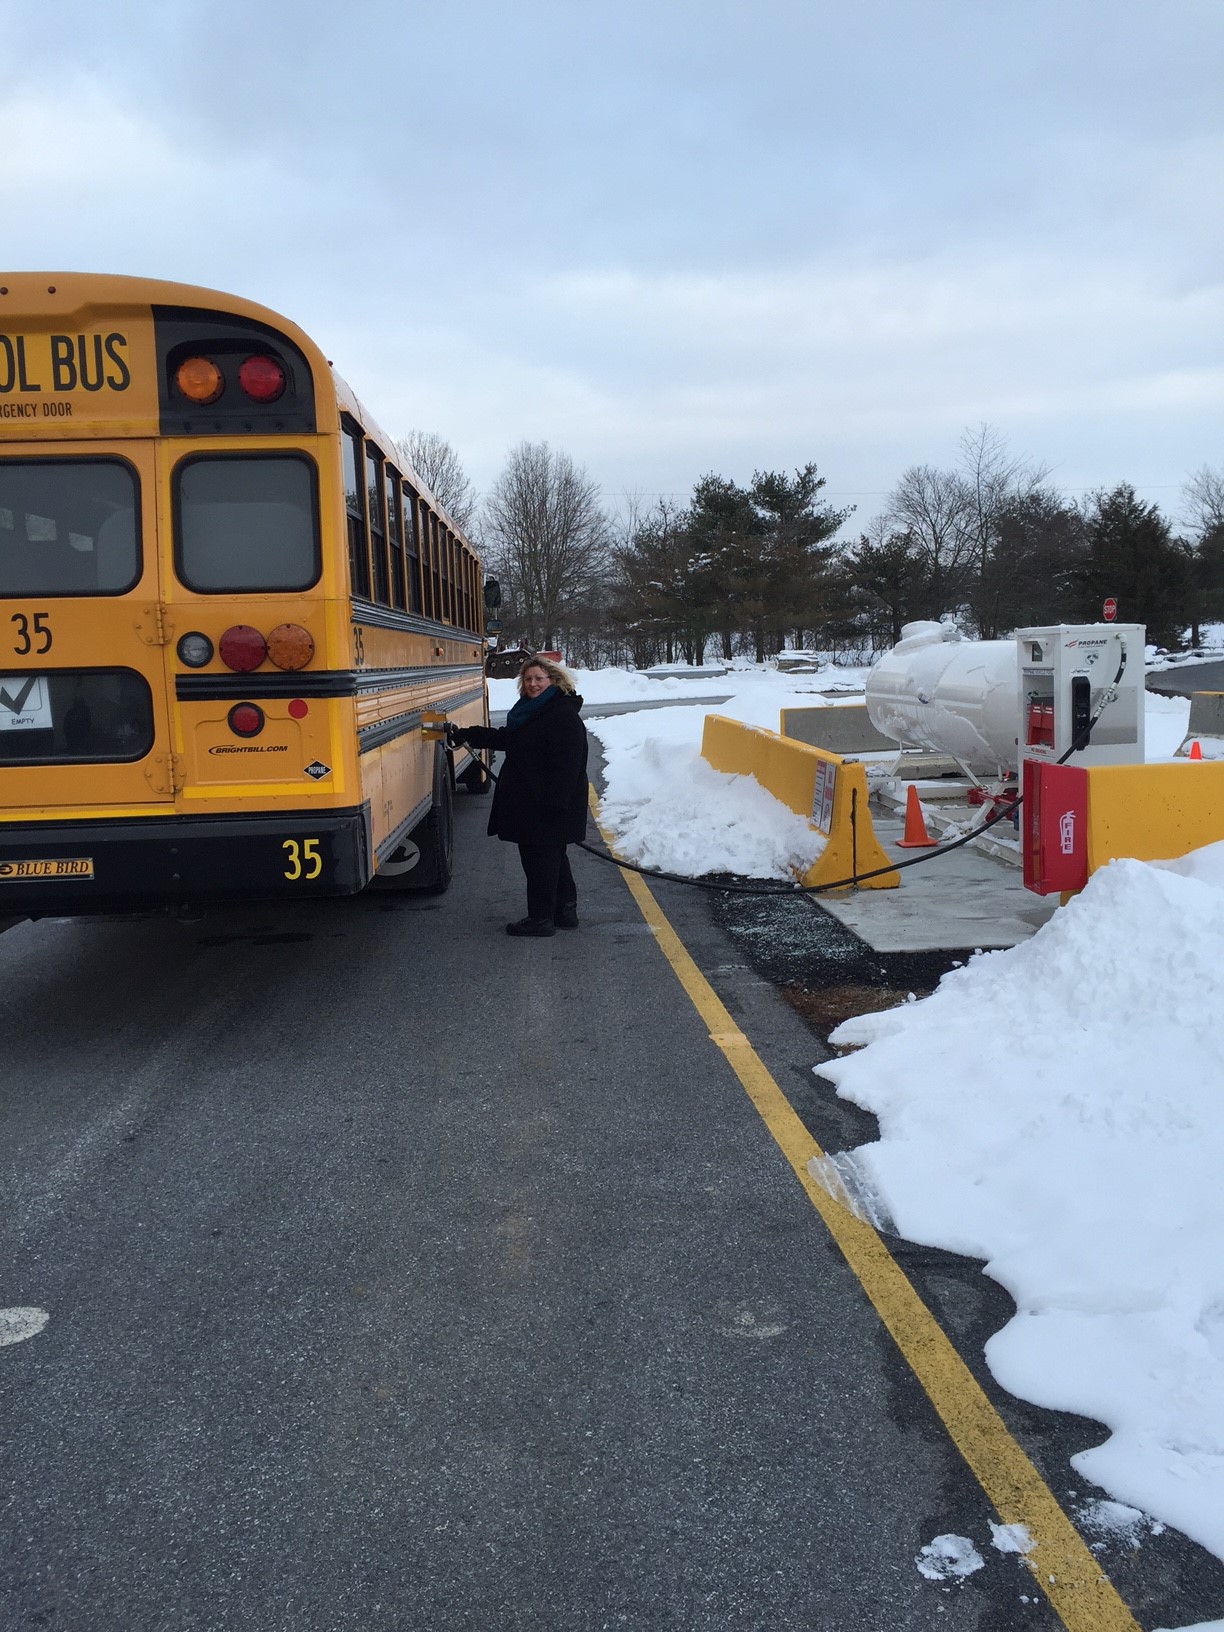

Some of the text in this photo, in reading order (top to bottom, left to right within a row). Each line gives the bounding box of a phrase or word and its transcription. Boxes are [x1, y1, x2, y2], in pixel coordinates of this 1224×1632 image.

[51, 333, 131, 392] BUS
[43, 402, 73, 417] DOOR
[1104, 605, 1116, 614] STOP
[11, 613, 53, 656] 35
[353, 626, 365, 666] 35
[11, 718, 35, 726] EMPTY
[308, 766, 326, 774] PROPANE
[1064, 822, 1072, 851] FIRE
[16, 861, 89, 876] BLUE BIRD
[282, 838, 323, 880] 35
